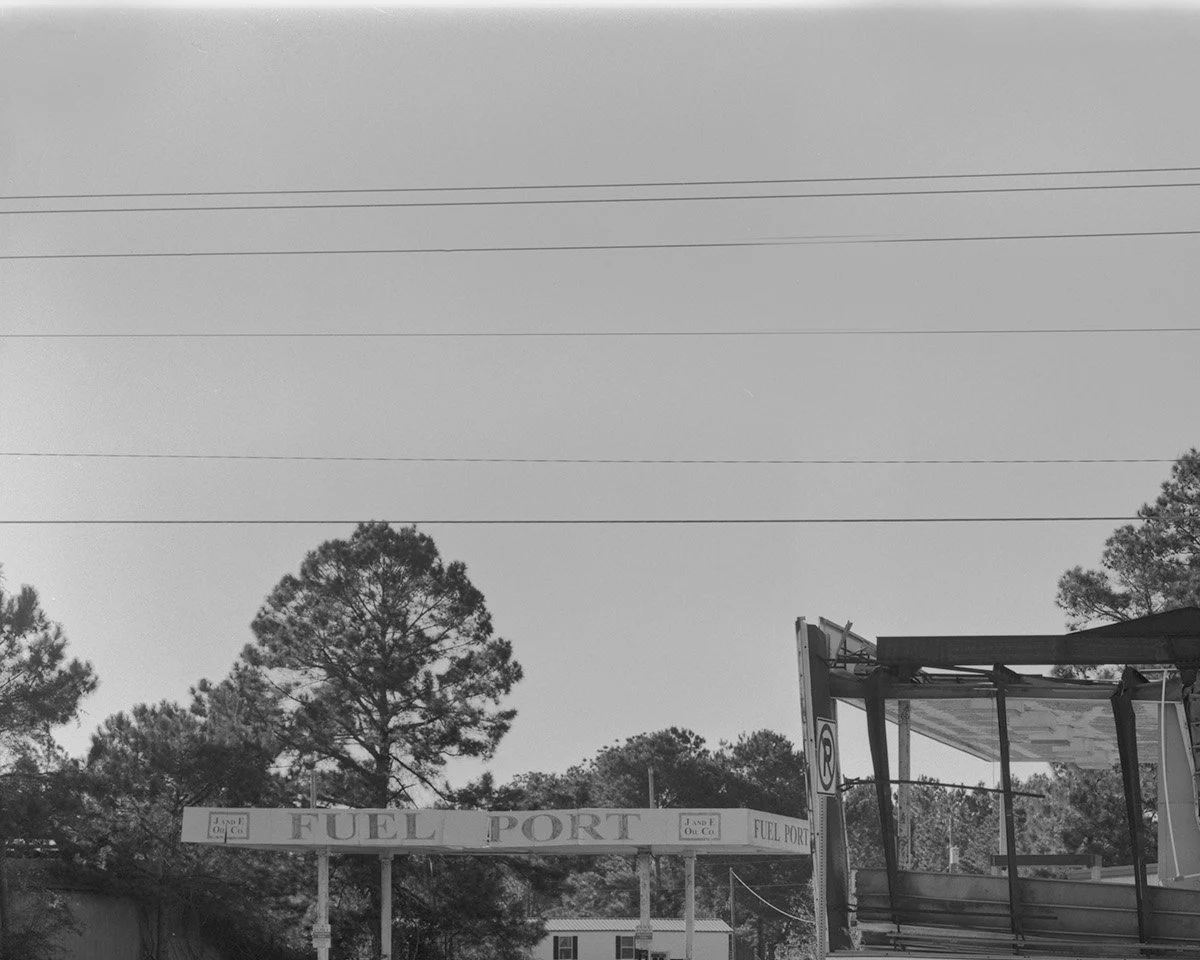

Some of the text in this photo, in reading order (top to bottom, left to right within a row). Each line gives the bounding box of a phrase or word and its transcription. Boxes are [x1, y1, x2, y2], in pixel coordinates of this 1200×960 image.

[288, 812, 642, 843] FUEL PORT
[754, 819, 809, 846] FUEL PORT
